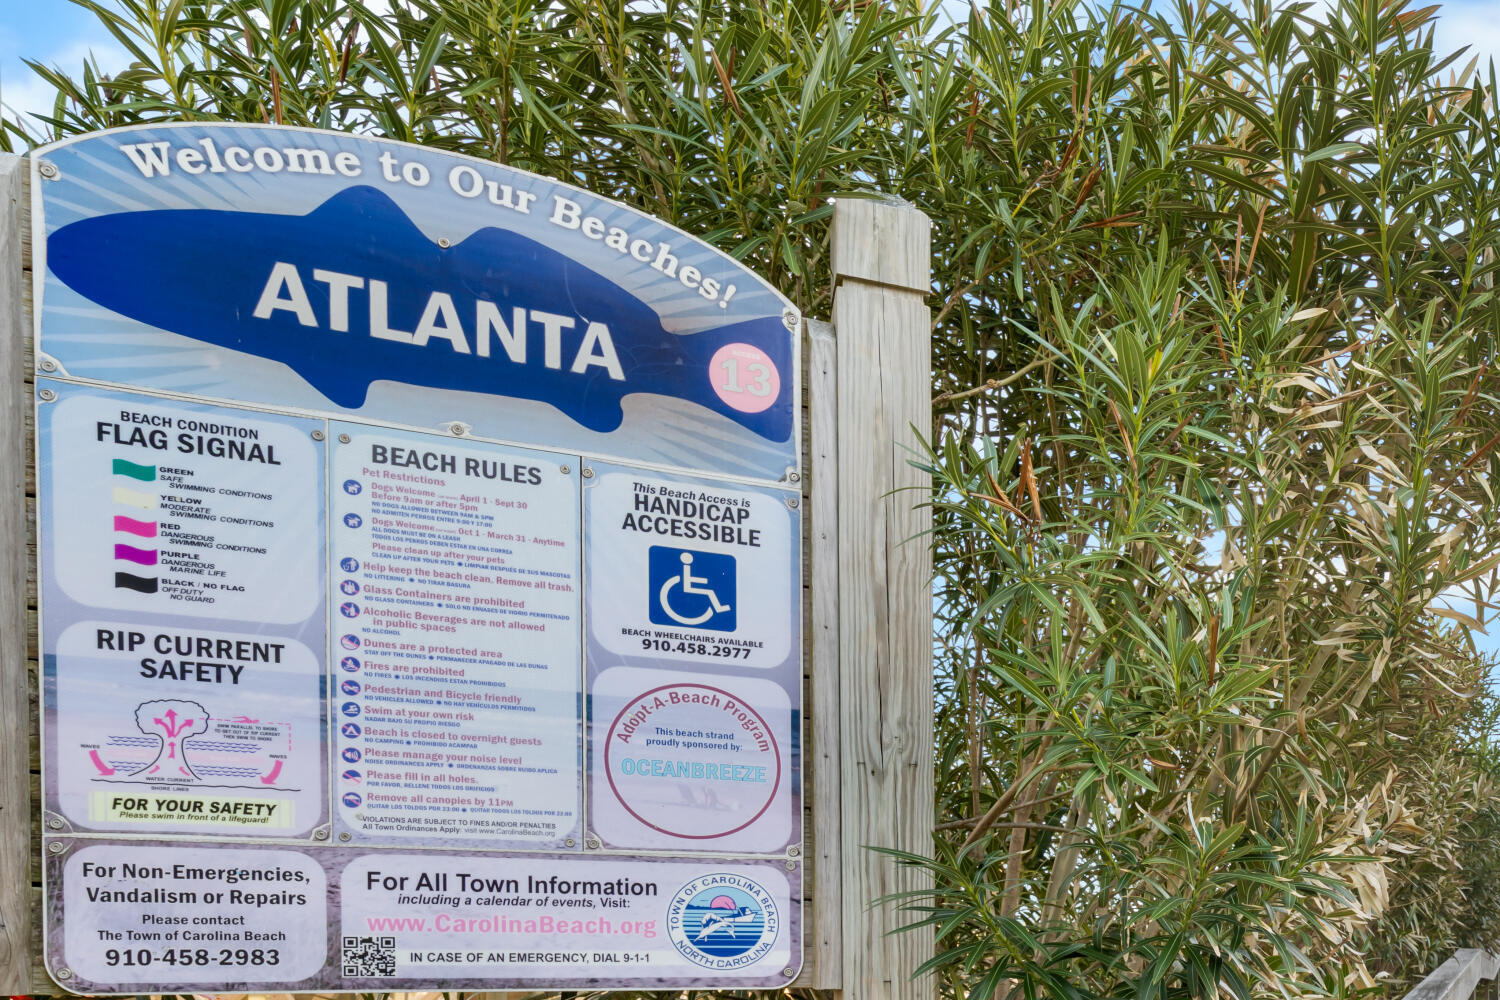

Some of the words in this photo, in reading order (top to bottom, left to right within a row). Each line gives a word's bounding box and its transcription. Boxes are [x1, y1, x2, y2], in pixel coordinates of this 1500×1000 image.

[121, 140, 362, 180] Welcome
[382, 153, 430, 188] to
[448, 164, 537, 214] Our
[550, 196, 738, 309] Beaches!
[253, 261, 626, 381] ATLANTA
[721, 359, 771, 397] 13
[121, 411, 172, 428] BEACH
[178, 419, 258, 439] CONDITION
[97, 422, 167, 450] FLAG
[178, 433, 281, 465] SIGNAL
[159, 467, 194, 476] GREEN
[372, 444, 456, 474] BEACH
[465, 458, 542, 485] RULES
[160, 475, 183, 483] SAFE
[160, 495, 202, 504] YELLOW
[169, 483, 216, 494] SWIMMING
[219, 488, 272, 500] CONDITIONS
[633, 482, 655, 495] This
[660, 487, 695, 500] Beach
[699, 493, 738, 506] Access
[741, 498, 750, 507] is
[160, 503, 211, 514] MODERATE
[634, 494, 750, 525] HANDICAP
[170, 510, 216, 521] SWIMMING
[220, 516, 274, 528] CONDITIONS
[161, 531, 214, 542] DANGEROUS
[622, 513, 761, 547] ACCESSIBLE
[169, 538, 213, 548] SWIMMING
[216, 543, 267, 554] CONDITIONS
[161, 551, 199, 560] PURPLE
[161, 559, 215, 569] DANGEROUS
[170, 566, 204, 575] MARINE
[162, 579, 195, 587] BLACK
[221, 584, 245, 592] FLAG
[162, 586, 179, 594] OFF
[181, 588, 204, 596] DUTY
[185, 595, 214, 603] GUARD
[363, 584, 392, 596] Glass
[395, 587, 451, 601] Containers
[455, 593, 471, 603] are
[474, 595, 524, 609] prohibited
[97, 629, 145, 652] RIP
[154, 634, 285, 663] CURRENT
[622, 628, 651, 636] BEACH
[654, 632, 715, 643] WHEELCHAIRS
[718, 637, 763, 648] AVAILABLE
[364, 639, 397, 650] Dunes
[400, 642, 416, 651] are
[428, 644, 477, 657] protected
[480, 649, 502, 658] area
[642, 639, 751, 659] 910.458.2977
[140, 659, 244, 685] SAFETY
[364, 661, 389, 671] Fires
[392, 664, 409, 672] are
[412, 664, 464, 677] prohibited
[364, 684, 421, 696] Pedestrian
[424, 688, 442, 697] and
[445, 690, 481, 703] Bicycle
[484, 692, 522, 704] friendly
[364, 706, 392, 716] Swim
[395, 709, 406, 717] at
[408, 710, 426, 720] your
[456, 712, 474, 721] risk
[617, 692, 720, 743] Adopt-A-Beach
[723, 701, 769, 752] Program
[656, 728, 673, 736] This
[676, 729, 703, 737] beach
[706, 731, 734, 740] strand
[646, 738, 679, 748] proudly
[682, 741, 728, 750] sponsored
[731, 743, 742, 751] by:
[622, 758, 767, 782] OCEANBREEZE
[112, 798, 148, 811] FOR
[156, 799, 205, 813] YOUR
[210, 802, 277, 816] SAFETY
[120, 811, 149, 819] Please
[187, 813, 208, 821] front
[210, 814, 219, 822] of
[229, 815, 268, 824] lifeguard!
[83, 862, 116, 877] For
[123, 863, 310, 885] Non-Emergencies,
[367, 872, 408, 891] For
[416, 873, 447, 891] All
[456, 874, 519, 893] Town
[528, 876, 657, 896] Information
[86, 887, 196, 903] Vandalism
[203, 892, 224, 904] or
[230, 890, 306, 907] Repairs
[398, 894, 460, 907] including
[476, 896, 531, 907] calendar
[536, 897, 549, 907] of
[552, 899, 596, 909] events,
[600, 898, 630, 908] Visit:
[671, 897, 686, 930] TOWN
[685, 884, 698, 895] OF
[702, 877, 761, 896] CAROLINA
[761, 898, 775, 932] BEACH
[142, 915, 188, 925] Please
[193, 915, 245, 925] contact
[368, 914, 656, 938] www.CarolinaBeach.org
[98, 930, 122, 940] The
[126, 931, 160, 941] Town
[165, 931, 179, 941] of
[182, 931, 240, 941] Carolina
[245, 931, 286, 941] Beach
[106, 949, 280, 966] 910-458-2983
[410, 953, 422, 962] IN
[427, 953, 462, 962] CASE
[466, 953, 484, 962] OF
[487, 953, 504, 962] AN
[509, 953, 589, 964] EMERGENCY,
[593, 953, 619, 962] DIAL
[623, 953, 649, 962] 9-1-1
[677, 940, 715, 966] NORTH
[717, 942, 771, 967] CAROLINA
